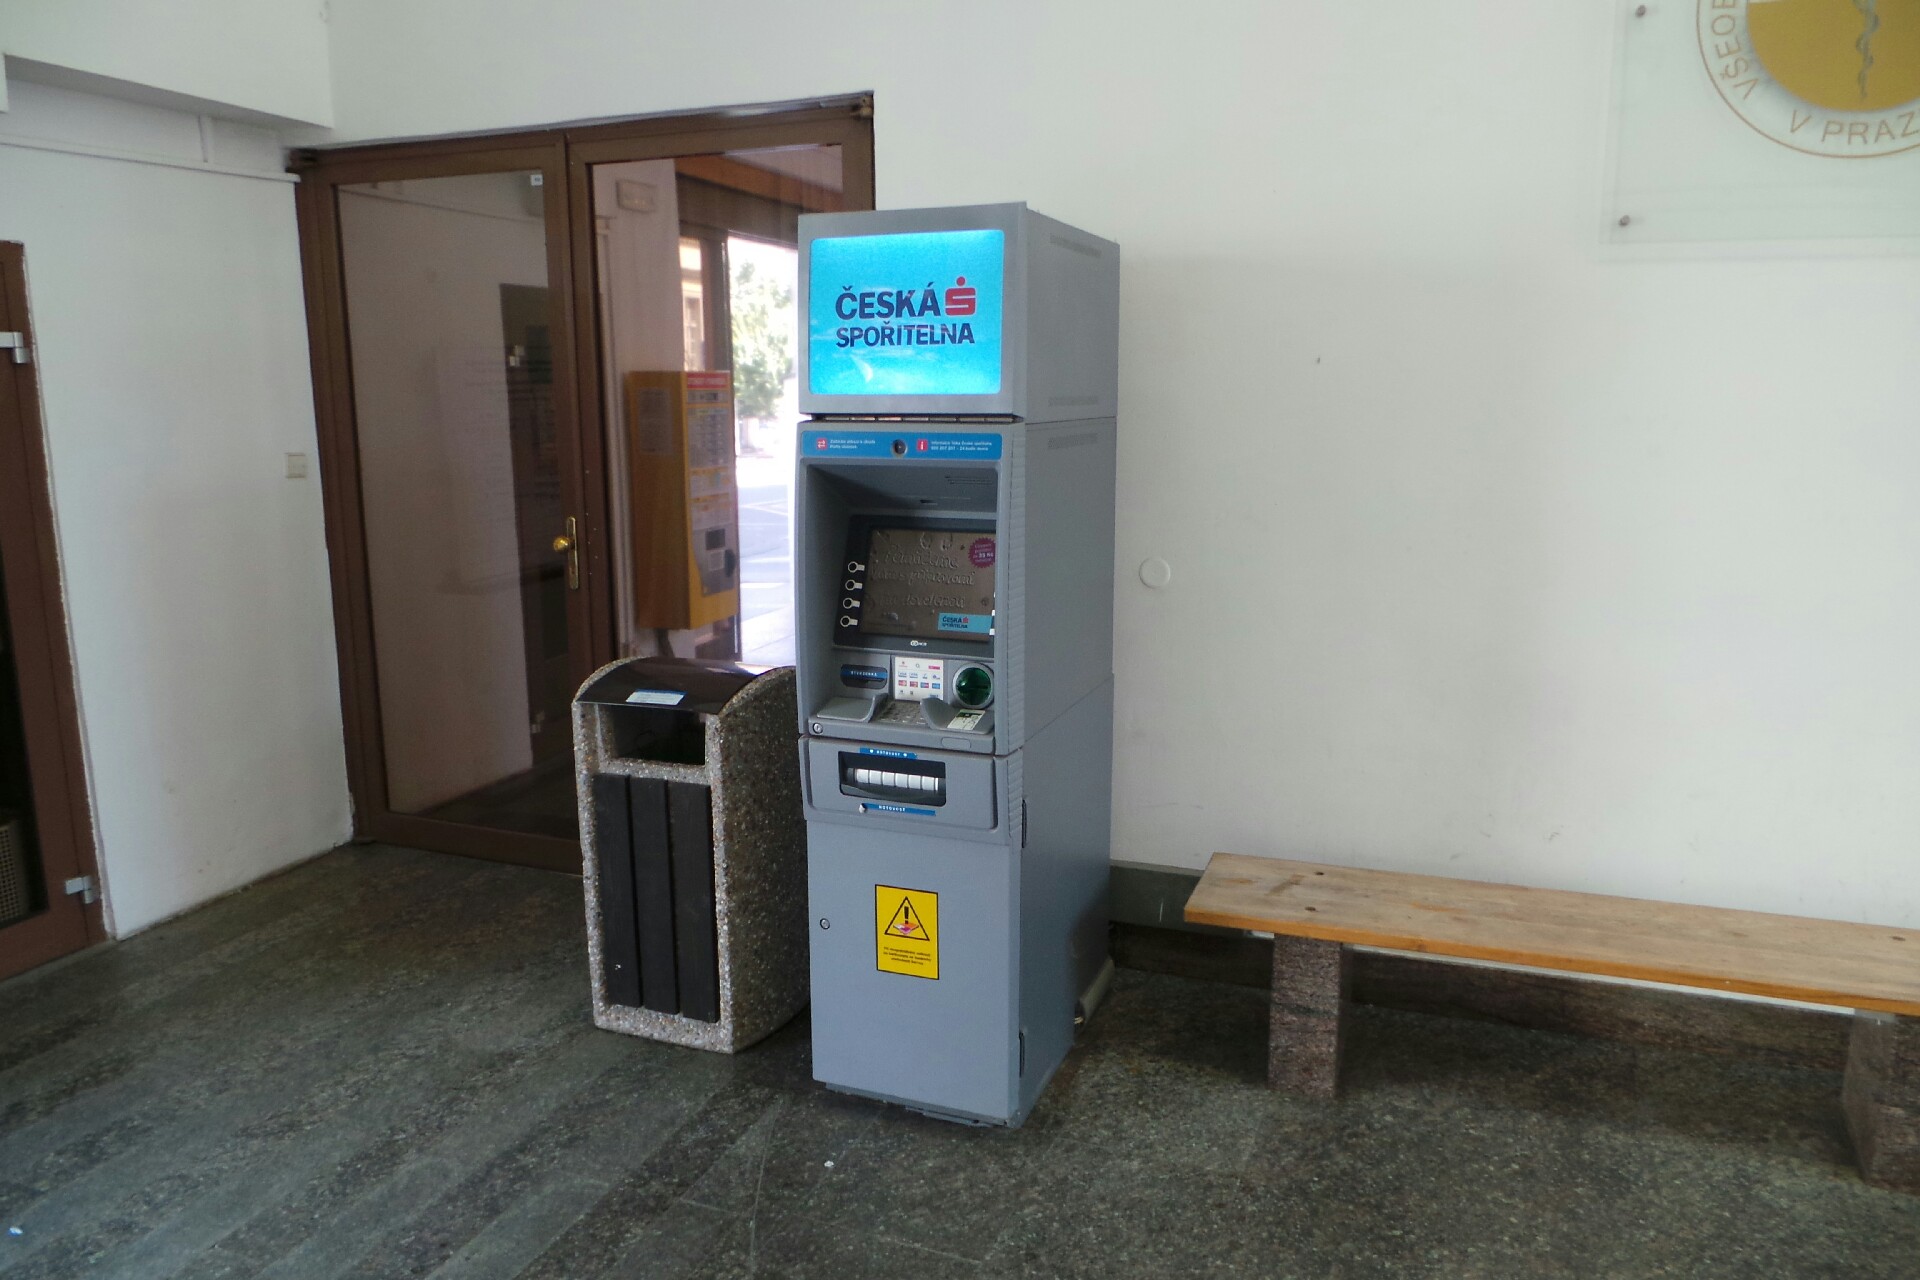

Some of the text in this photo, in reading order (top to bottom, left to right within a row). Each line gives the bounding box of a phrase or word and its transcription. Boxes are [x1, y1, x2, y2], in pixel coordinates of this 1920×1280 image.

[1790, 109, 1813, 134] V
[835, 281, 941, 321] ČESKÁ
[835, 321, 975, 348] SPOŘITELNA
